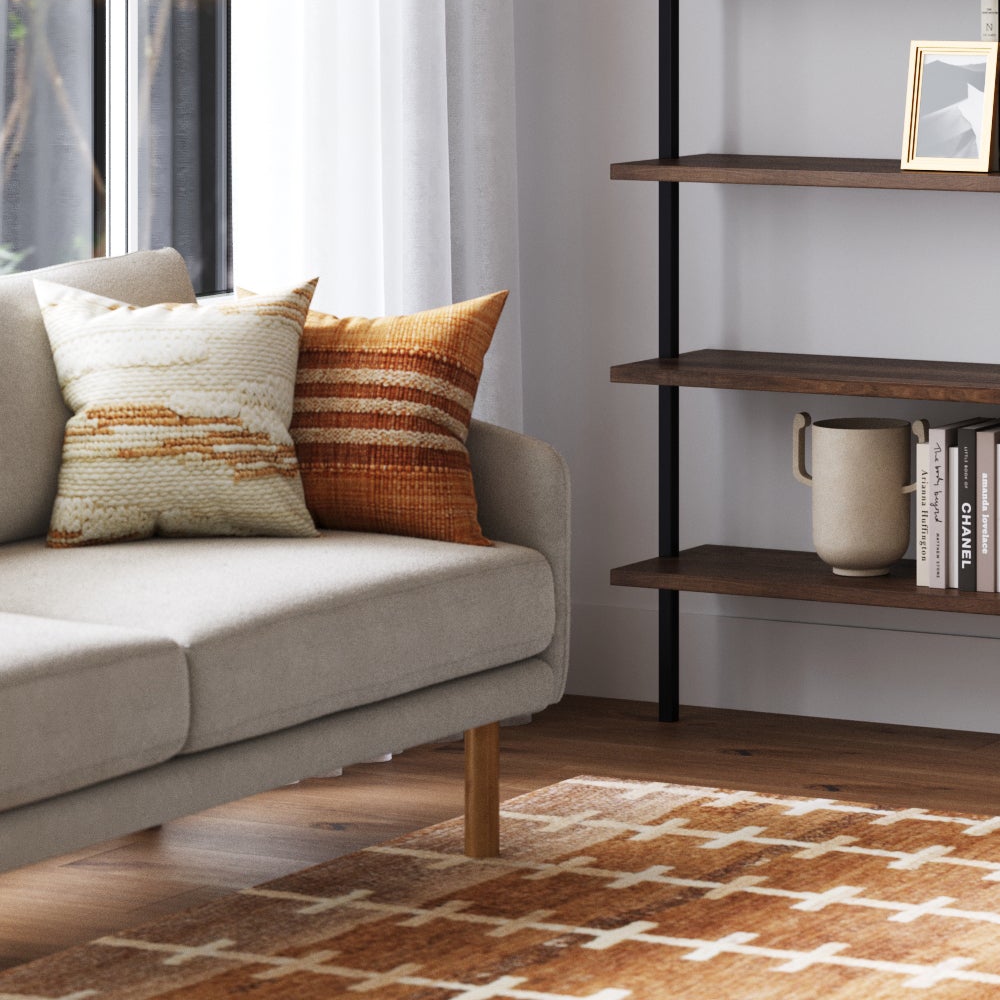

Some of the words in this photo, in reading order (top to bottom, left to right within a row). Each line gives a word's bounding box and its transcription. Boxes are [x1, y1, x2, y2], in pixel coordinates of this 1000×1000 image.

[933, 442, 942, 462] The
[933, 465, 944, 486] body
[982, 472, 990, 511] amanda
[930, 491, 943, 522] beyond
[919, 510, 929, 561] Huffington
[961, 502, 972, 569] CHANEL
[982, 514, 990, 555] lovelace
